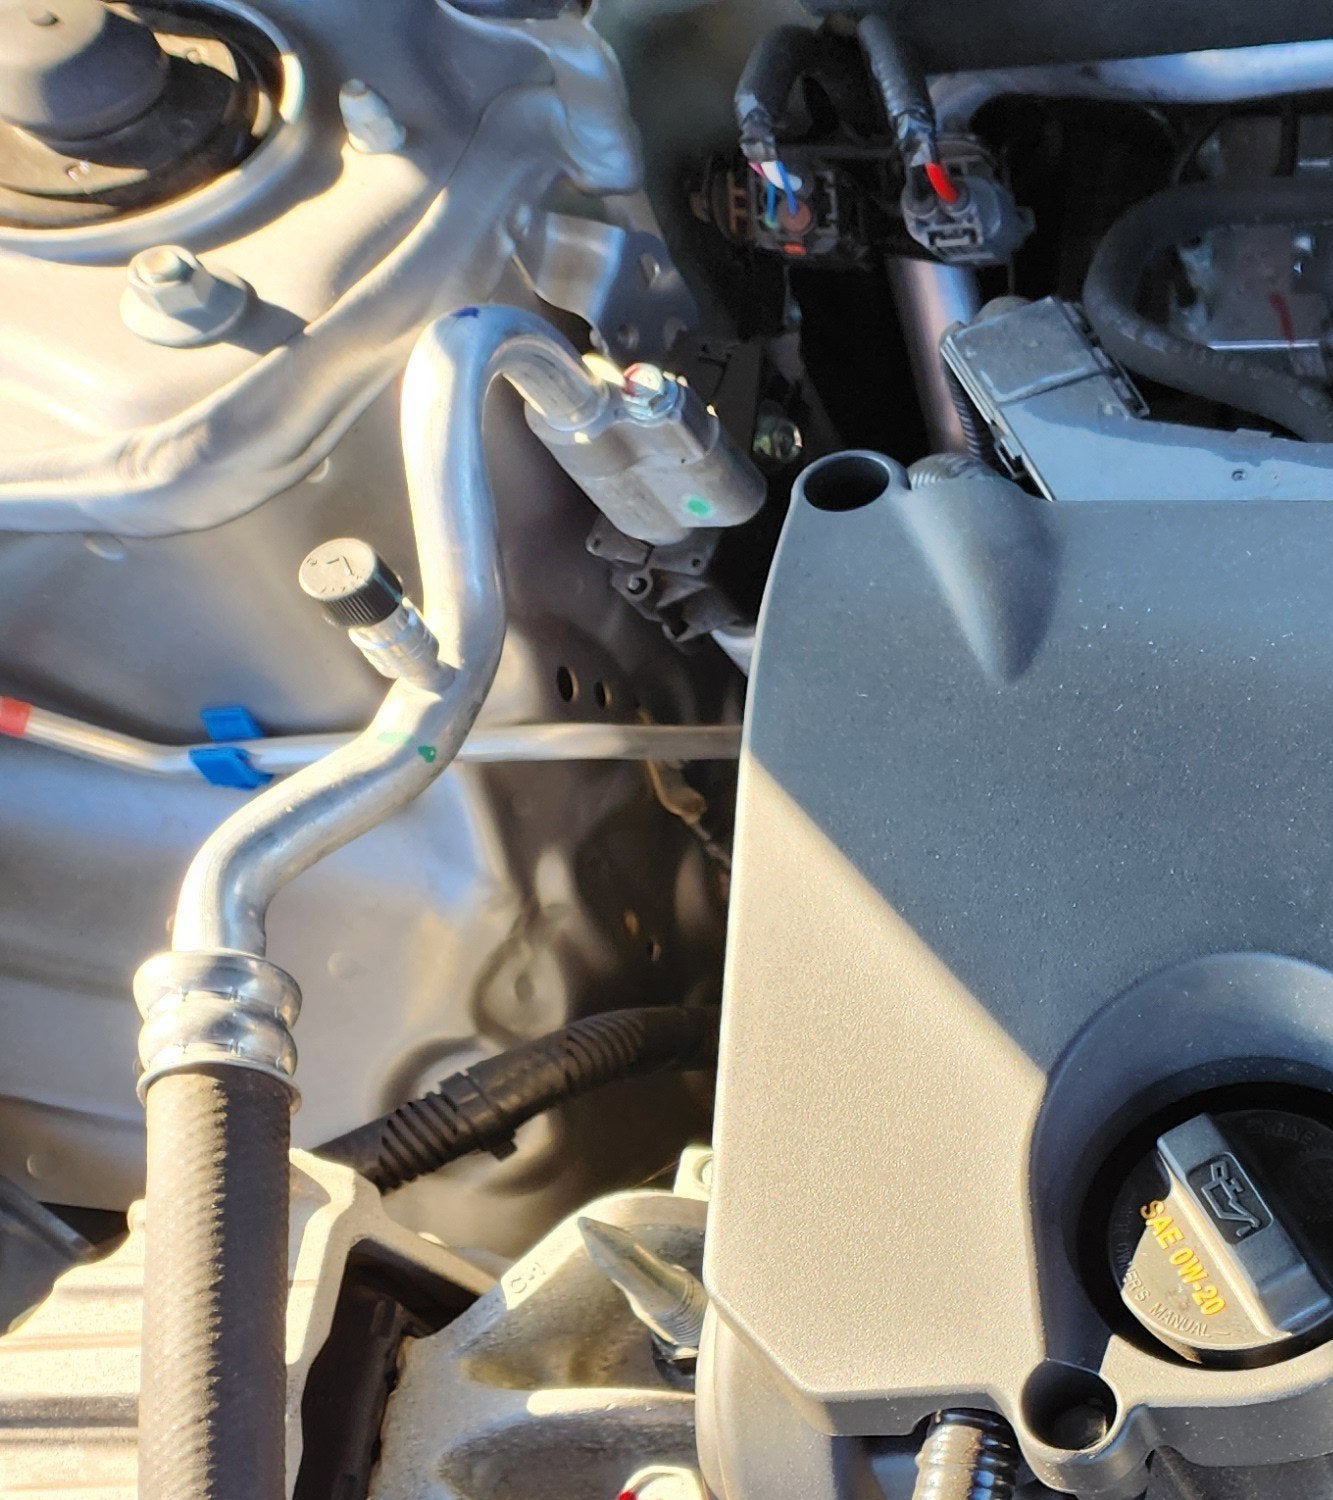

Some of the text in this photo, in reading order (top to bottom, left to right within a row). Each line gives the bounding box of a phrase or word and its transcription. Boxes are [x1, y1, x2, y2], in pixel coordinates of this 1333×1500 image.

[1140, 1199, 1227, 1317] SAE 0W-20
[1149, 1303, 1211, 1338] MANUAL
